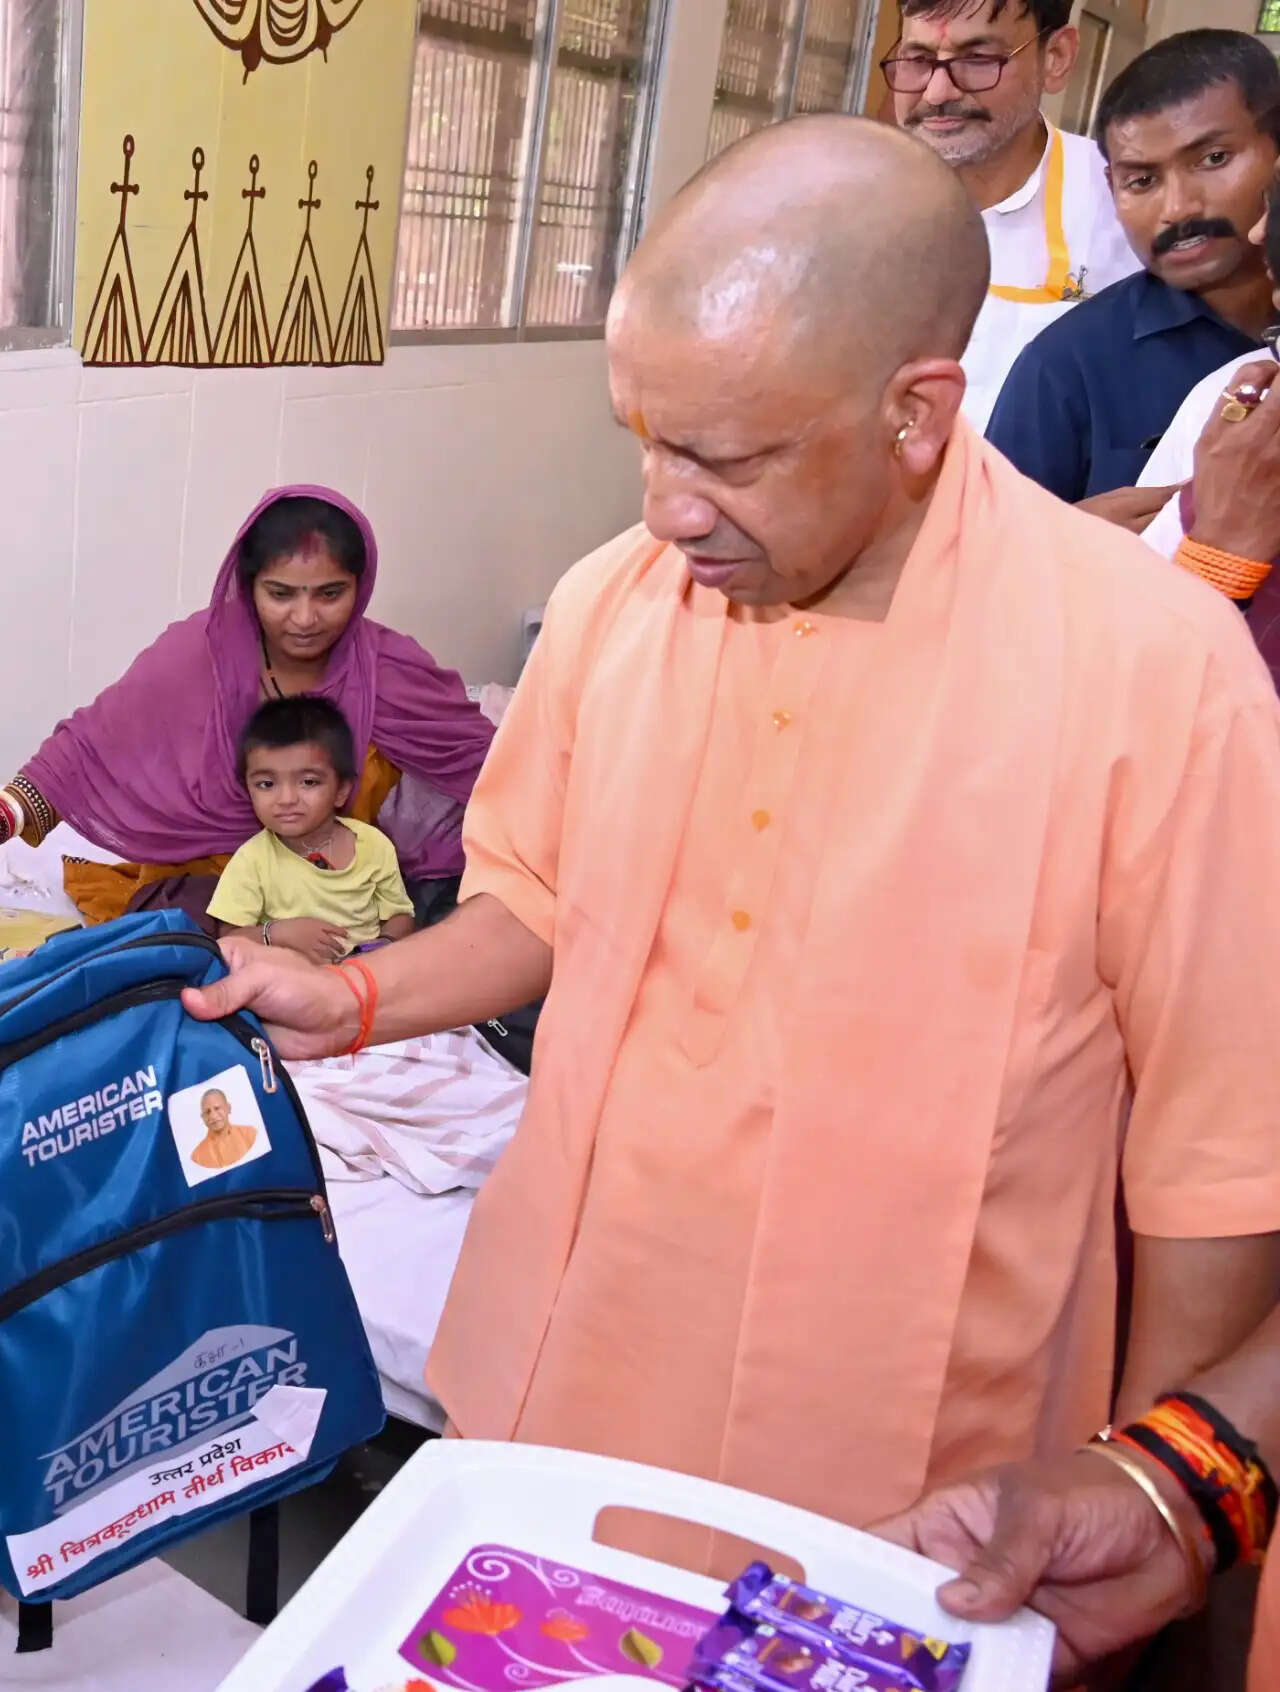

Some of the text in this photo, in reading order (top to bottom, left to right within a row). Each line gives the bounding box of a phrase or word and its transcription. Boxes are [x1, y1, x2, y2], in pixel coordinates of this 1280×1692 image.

[21, 1065, 157, 1146] AMERICAN
[22, 1090, 163, 1168] TOURISTER
[43, 1338, 297, 1486] AMERICAN
[149, 1438, 241, 1485] उत्तर प्रदेश
[27, 1554, 54, 1579] श्री
[60, 1490, 176, 1562] चित्रकूटधाम
[182, 1466, 225, 1499] तीर्थ
